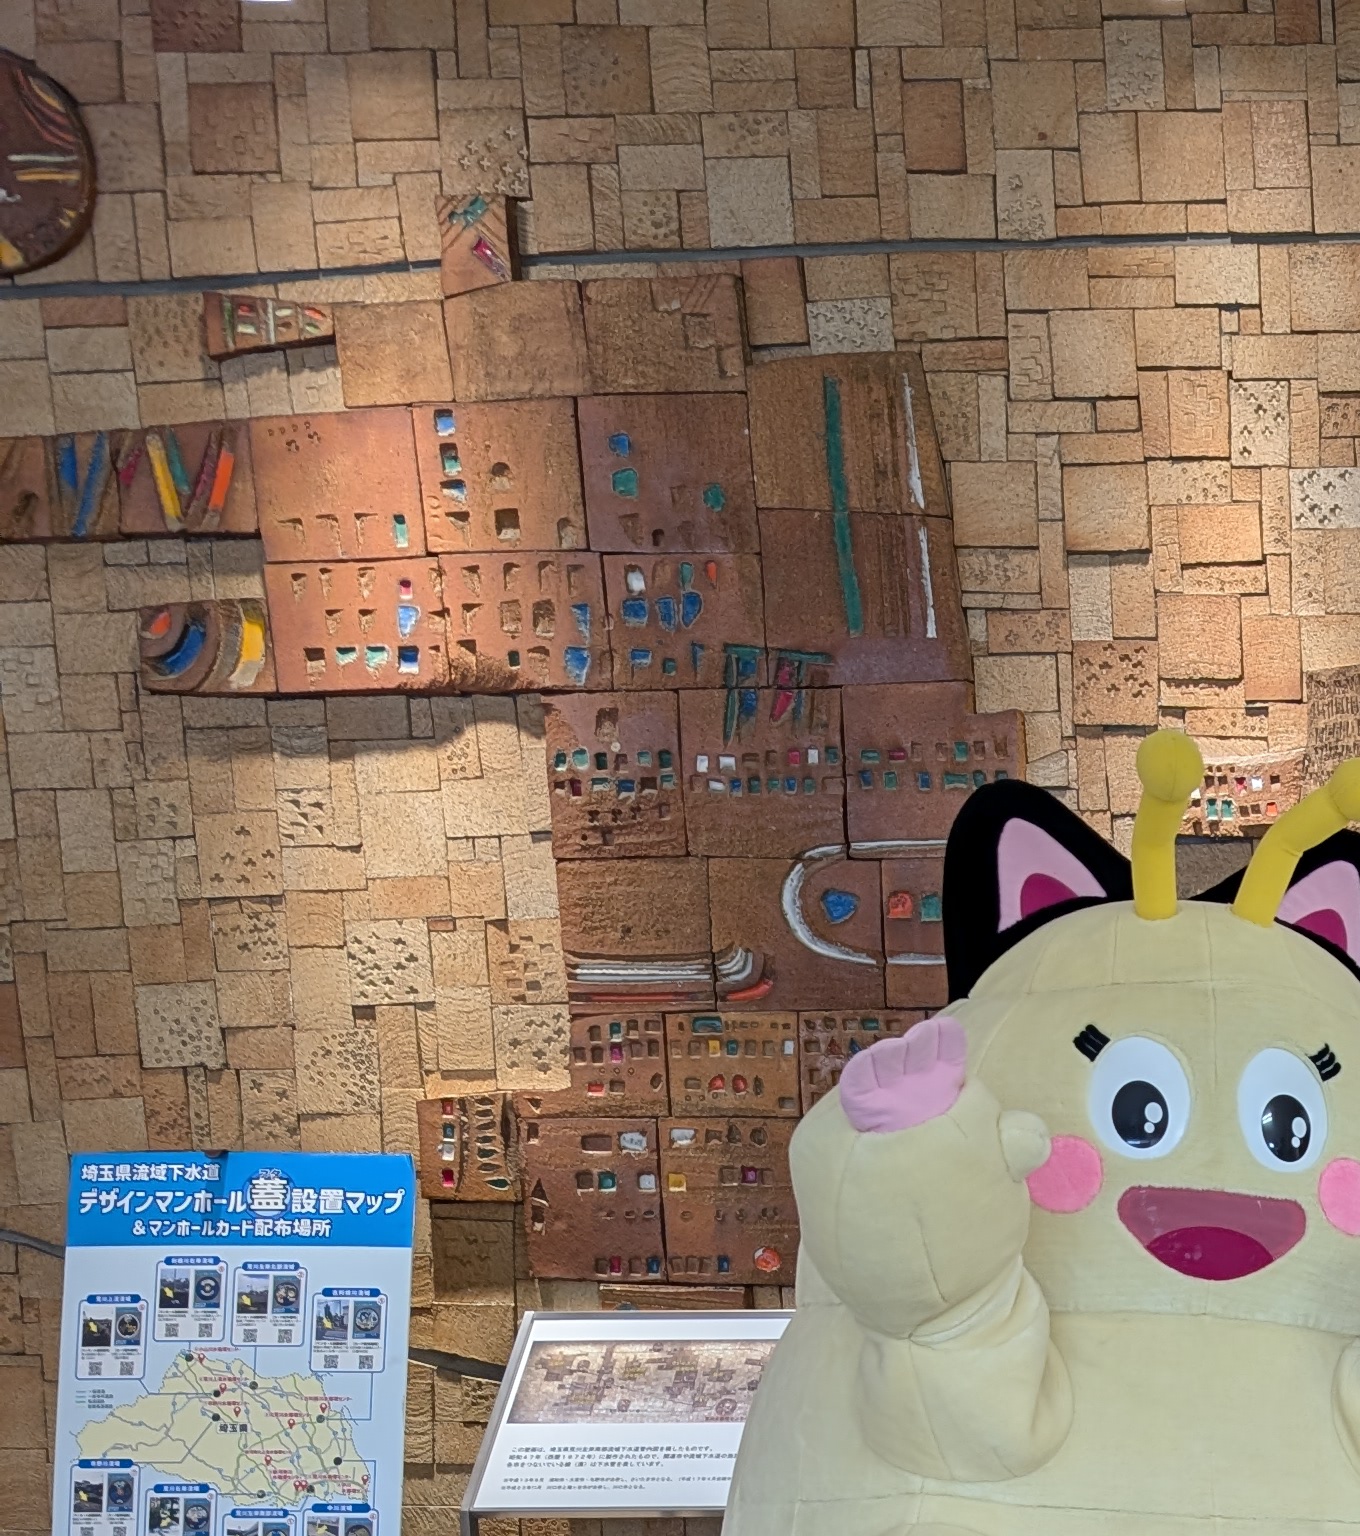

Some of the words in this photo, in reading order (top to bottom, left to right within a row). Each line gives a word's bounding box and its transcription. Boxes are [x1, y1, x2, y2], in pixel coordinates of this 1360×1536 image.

[81, 1163, 220, 1182] 埼玉県流域下水道
[79, 1177, 405, 1214] デザインマンホール蓋設置マップ
